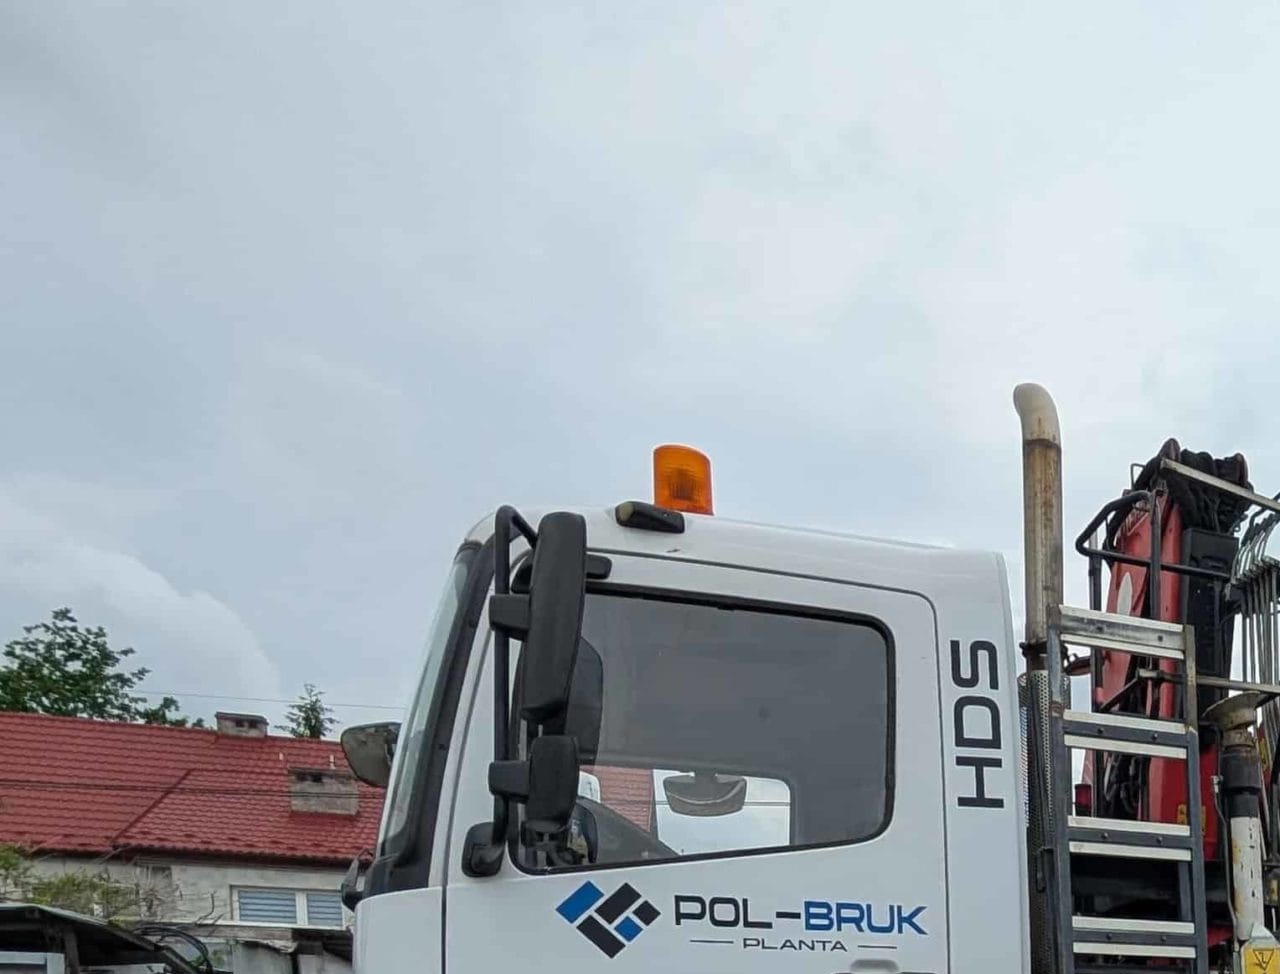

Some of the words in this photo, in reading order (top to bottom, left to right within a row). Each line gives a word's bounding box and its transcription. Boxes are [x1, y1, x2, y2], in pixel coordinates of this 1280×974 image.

[950, 640, 1004, 808] HDS
[674, 895, 928, 936] POL-BRUK
[743, 938, 848, 952] PLANTA
